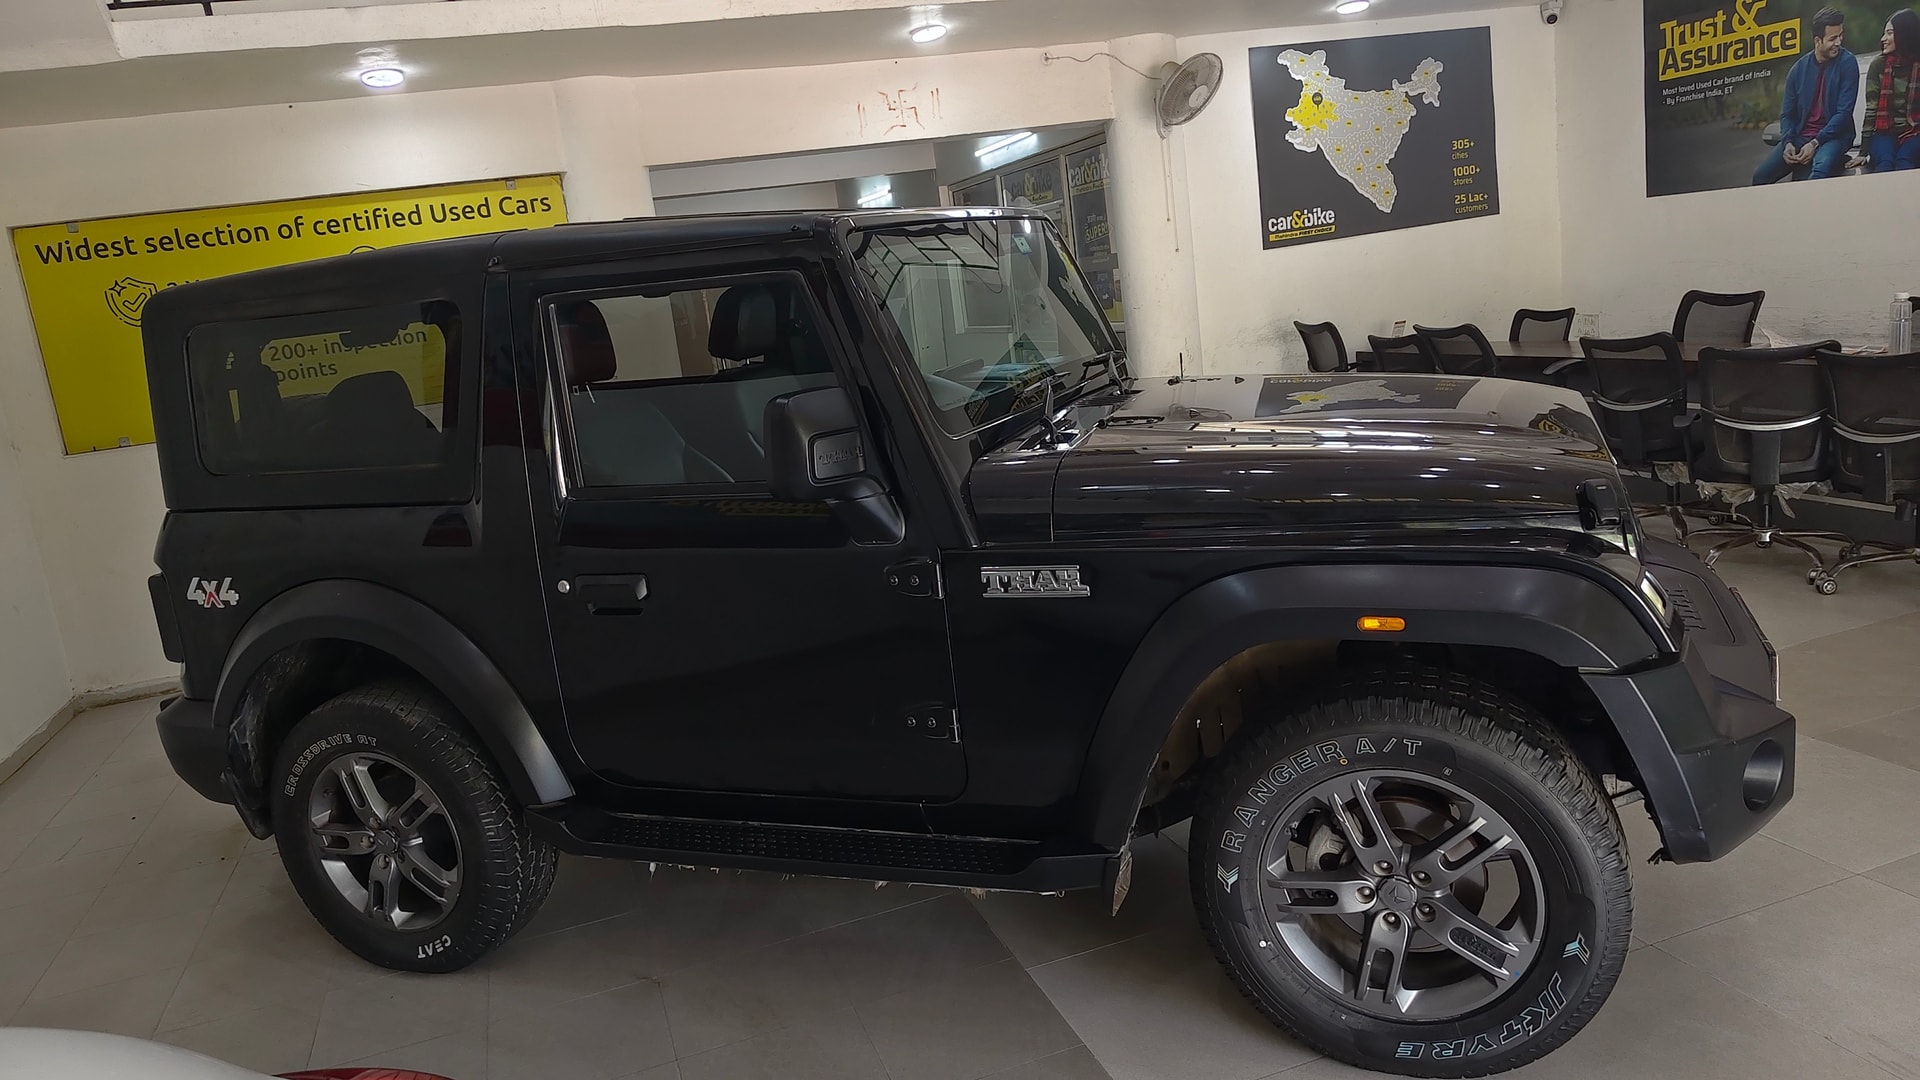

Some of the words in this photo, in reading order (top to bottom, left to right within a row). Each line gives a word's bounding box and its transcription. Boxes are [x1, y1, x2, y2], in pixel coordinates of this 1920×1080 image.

[1659, 9, 1727, 49] Trust
[1732, 0, 1767, 32] &
[1660, 27, 1798, 76] Assurance
[1662, 87, 1678, 96] Most
[1678, 83, 1695, 93] loved
[1696, 80, 1712, 90] Used
[1713, 79, 1723, 87] Car
[1724, 75, 1744, 85] brand
[1744, 73, 1752, 81] of
[1753, 69, 1771, 79] India
[1666, 97, 1675, 105] By
[1676, 92, 1704, 103] Franchise
[1705, 89, 1723, 98] India,
[1724, 86, 1734, 95] ET
[1451, 139, 1475, 151] 305+
[1451, 151, 1469, 160] cities
[1453, 165, 1481, 177] 1000+
[1453, 177, 1473, 186] stores
[1454, 194, 1467, 205] 25
[1468, 193, 1489, 203] Lac+
[1455, 203, 1489, 214] customers
[34, 235, 138, 265] Widest
[144, 223, 270, 254] selection
[277, 215, 305, 240] of
[312, 204, 422, 236] certified
[429, 197, 492, 224] Used
[498, 196, 552, 216] Cars
[1268, 207, 1335, 232] car&bike
[268, 342, 319, 362] 200+
[275, 362, 338, 385] points
[980, 565, 1091, 598] THAR
[284, 733, 353, 797] CROSSDRIVE
[1220, 740, 1344, 854] RANGER
[1355, 736, 1425, 757] A/T
[417, 935, 452, 960] CEAT
